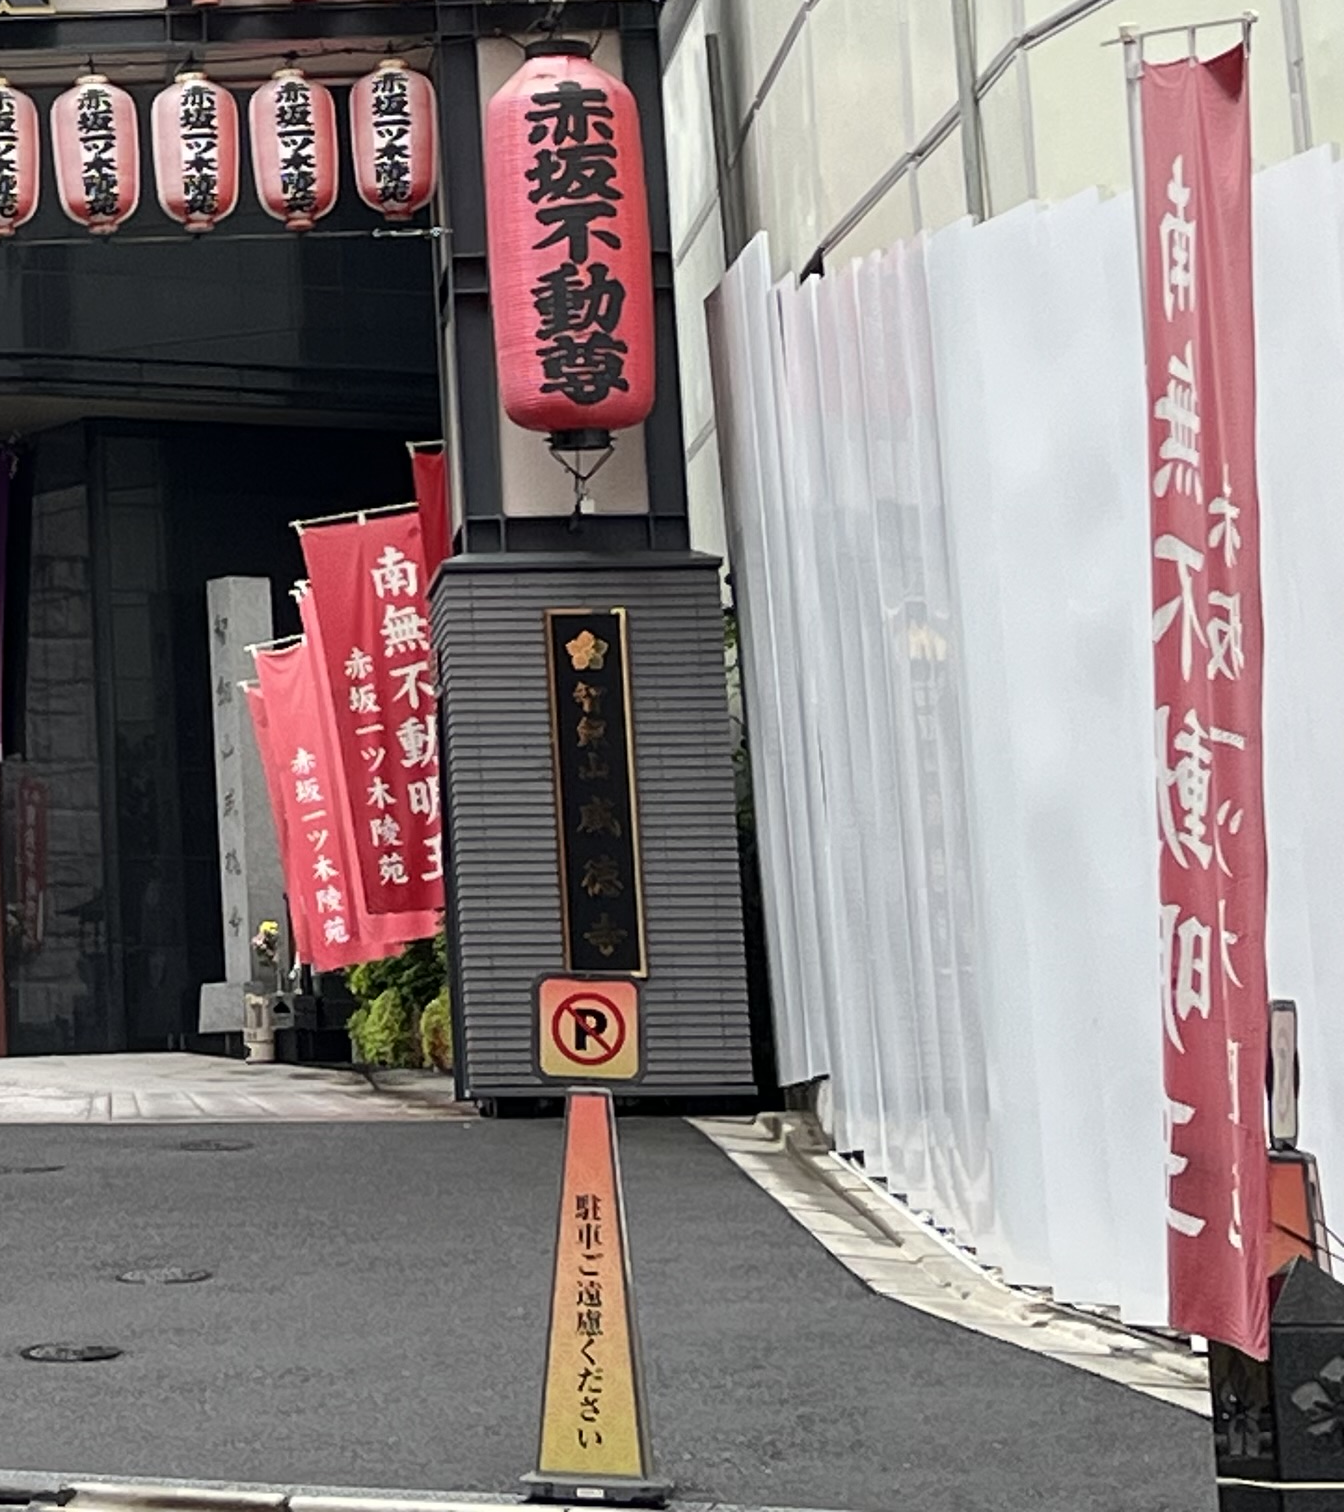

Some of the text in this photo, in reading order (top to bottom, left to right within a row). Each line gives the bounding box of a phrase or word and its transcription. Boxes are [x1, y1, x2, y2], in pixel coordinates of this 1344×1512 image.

[525, 80, 629, 405] 赤坂不動尊
[290, 747, 350, 947] 赤坂一ツ木陵苑
[344, 646, 409, 885] 赤坂一ツ木陵苑
[575, 1194, 604, 1450] 駐車ご遠慮ください
